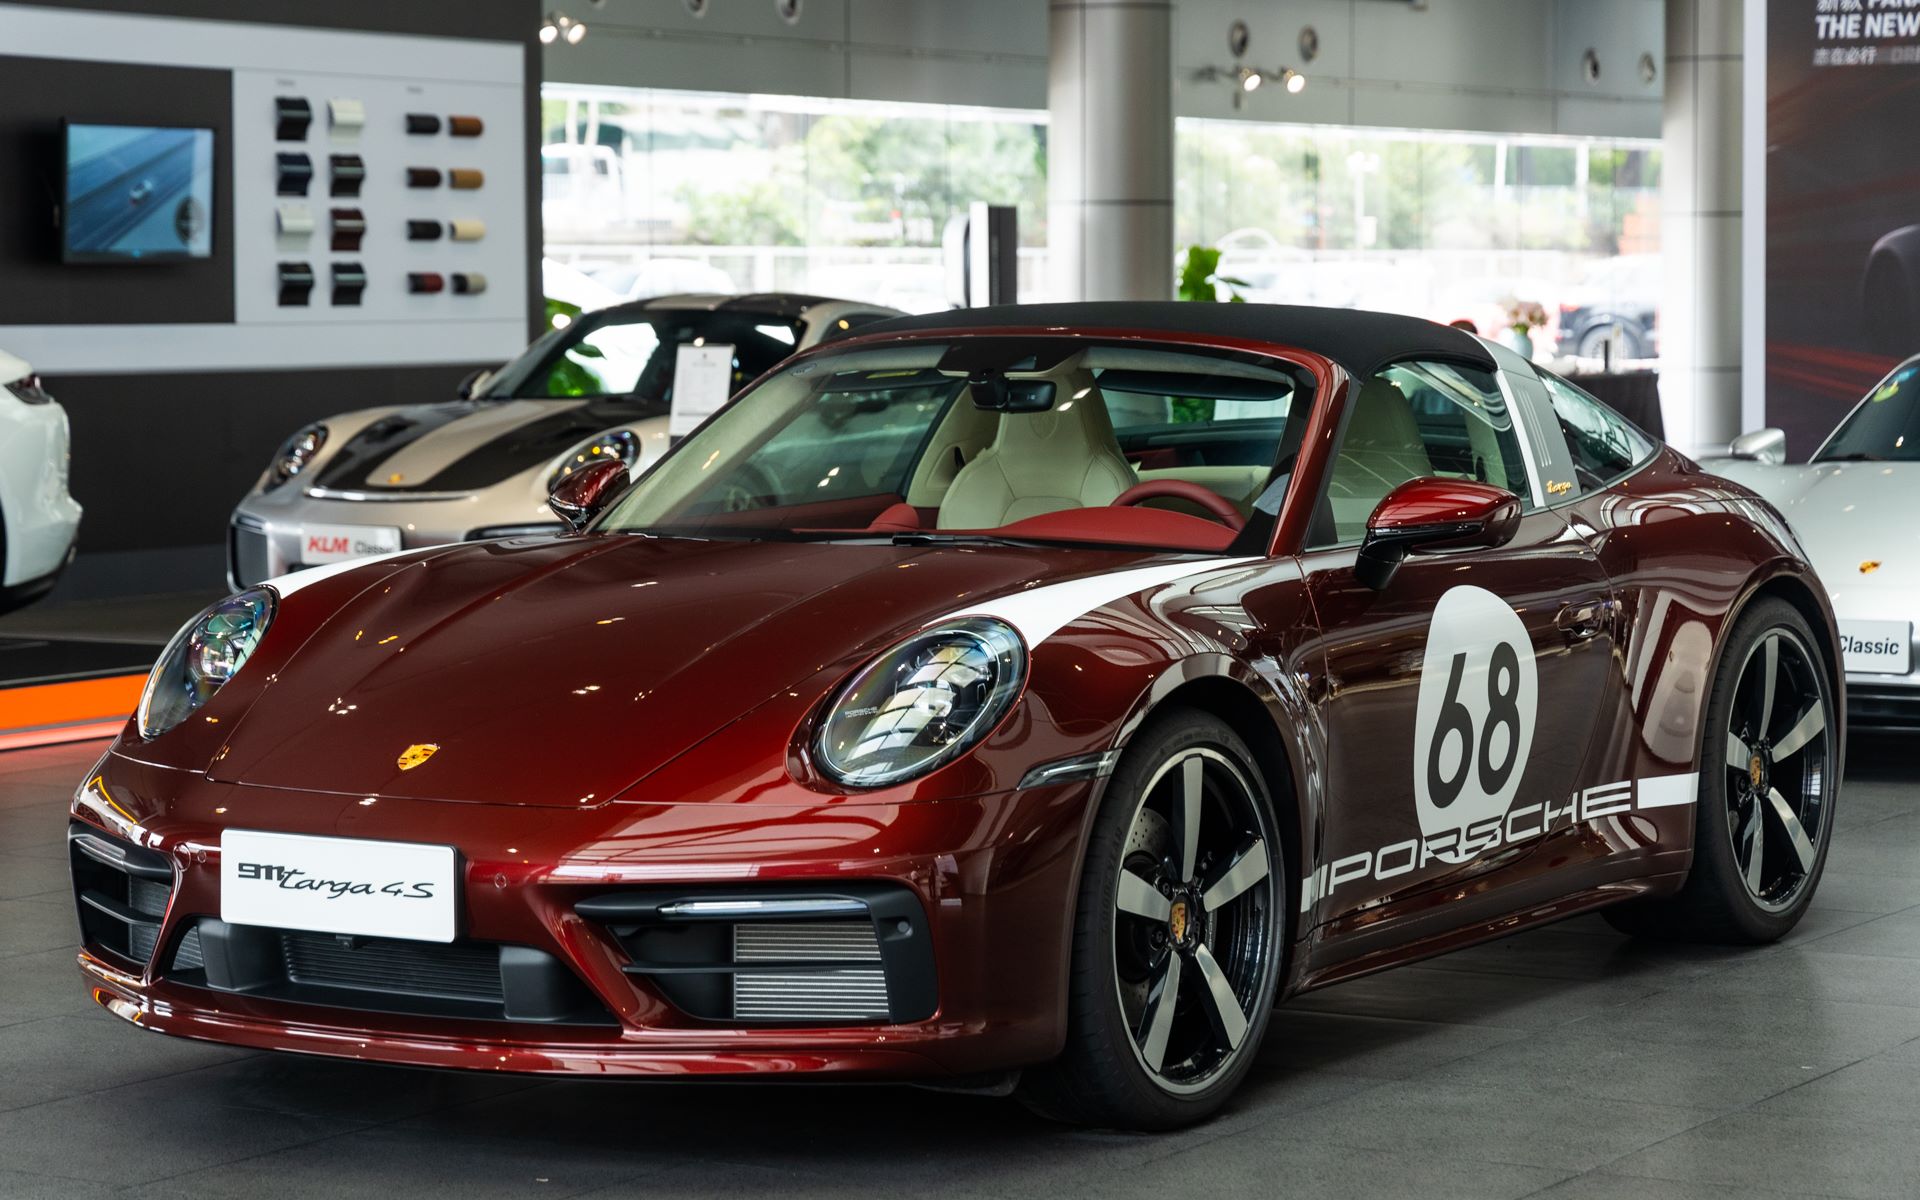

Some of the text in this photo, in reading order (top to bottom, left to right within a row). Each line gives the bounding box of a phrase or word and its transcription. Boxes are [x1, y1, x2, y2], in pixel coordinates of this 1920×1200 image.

[1815, 12, 1920, 40] THE NEW
[308, 536, 349, 554] KLM
[1840, 635, 1899, 655] Classic
[1427, 641, 1521, 809] 68
[1328, 780, 1632, 896] PORSCHE
[381, 881, 434, 899] 4S
